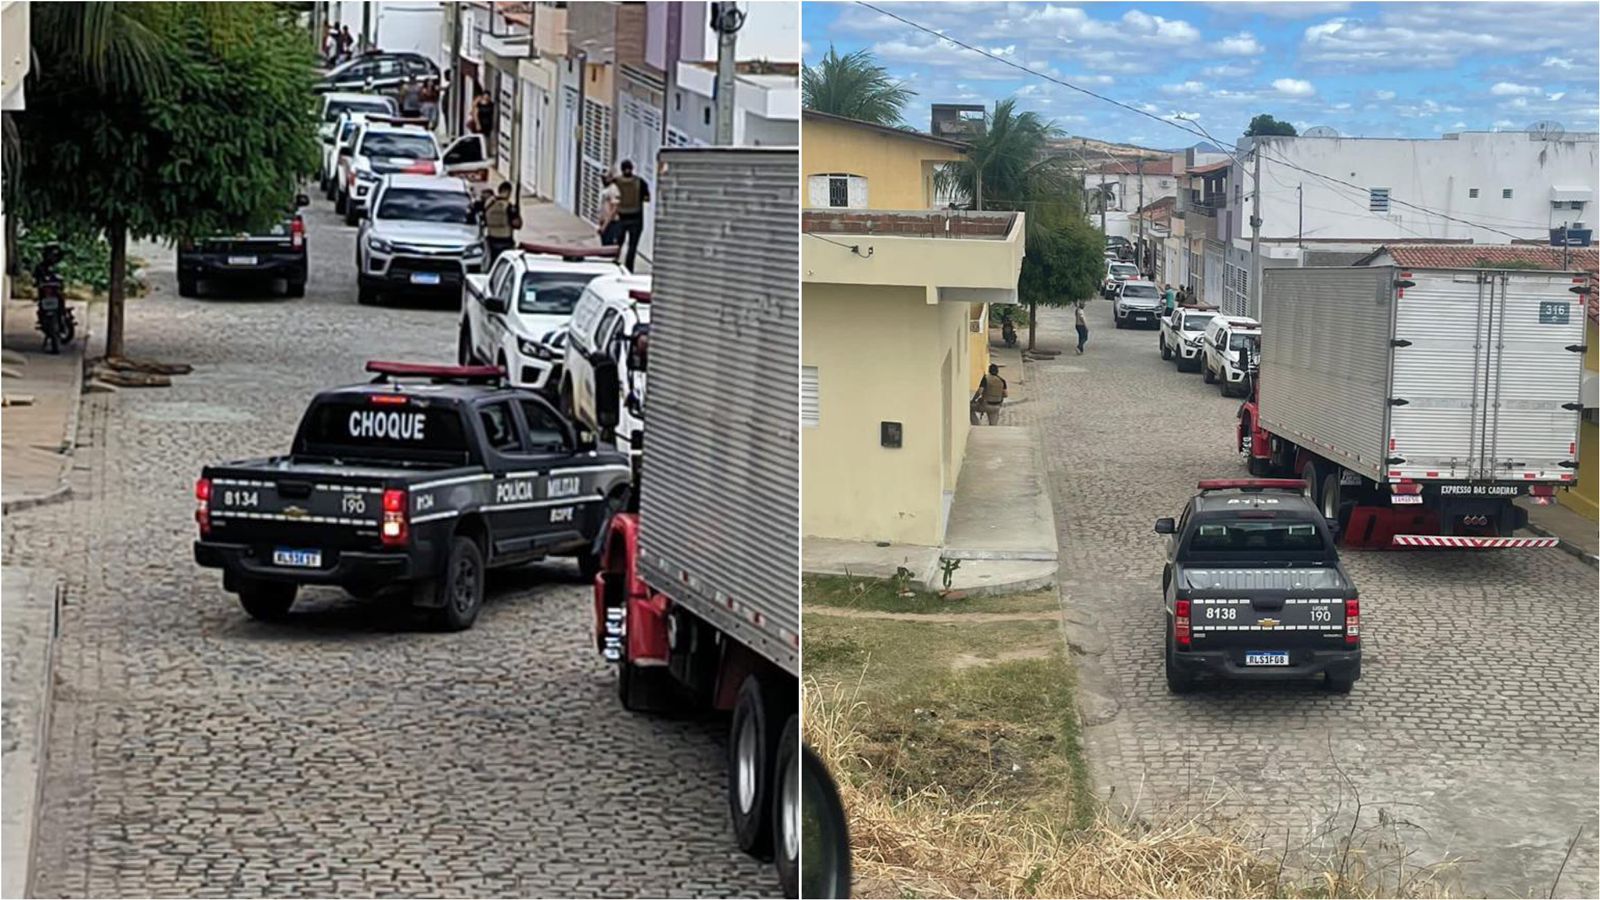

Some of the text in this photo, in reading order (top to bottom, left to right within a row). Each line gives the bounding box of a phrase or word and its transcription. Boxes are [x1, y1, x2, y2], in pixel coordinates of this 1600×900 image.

[1546, 304, 1565, 315] 316
[349, 411, 427, 440] CHOQUE
[547, 477, 580, 498] MILITAR
[1440, 485, 1518, 496] EXPRESSO DAS CADEIRAS
[224, 490, 258, 507] 8134
[341, 498, 366, 514] 190
[1206, 607, 1237, 620] 8138
[1310, 611, 1331, 622] 190
